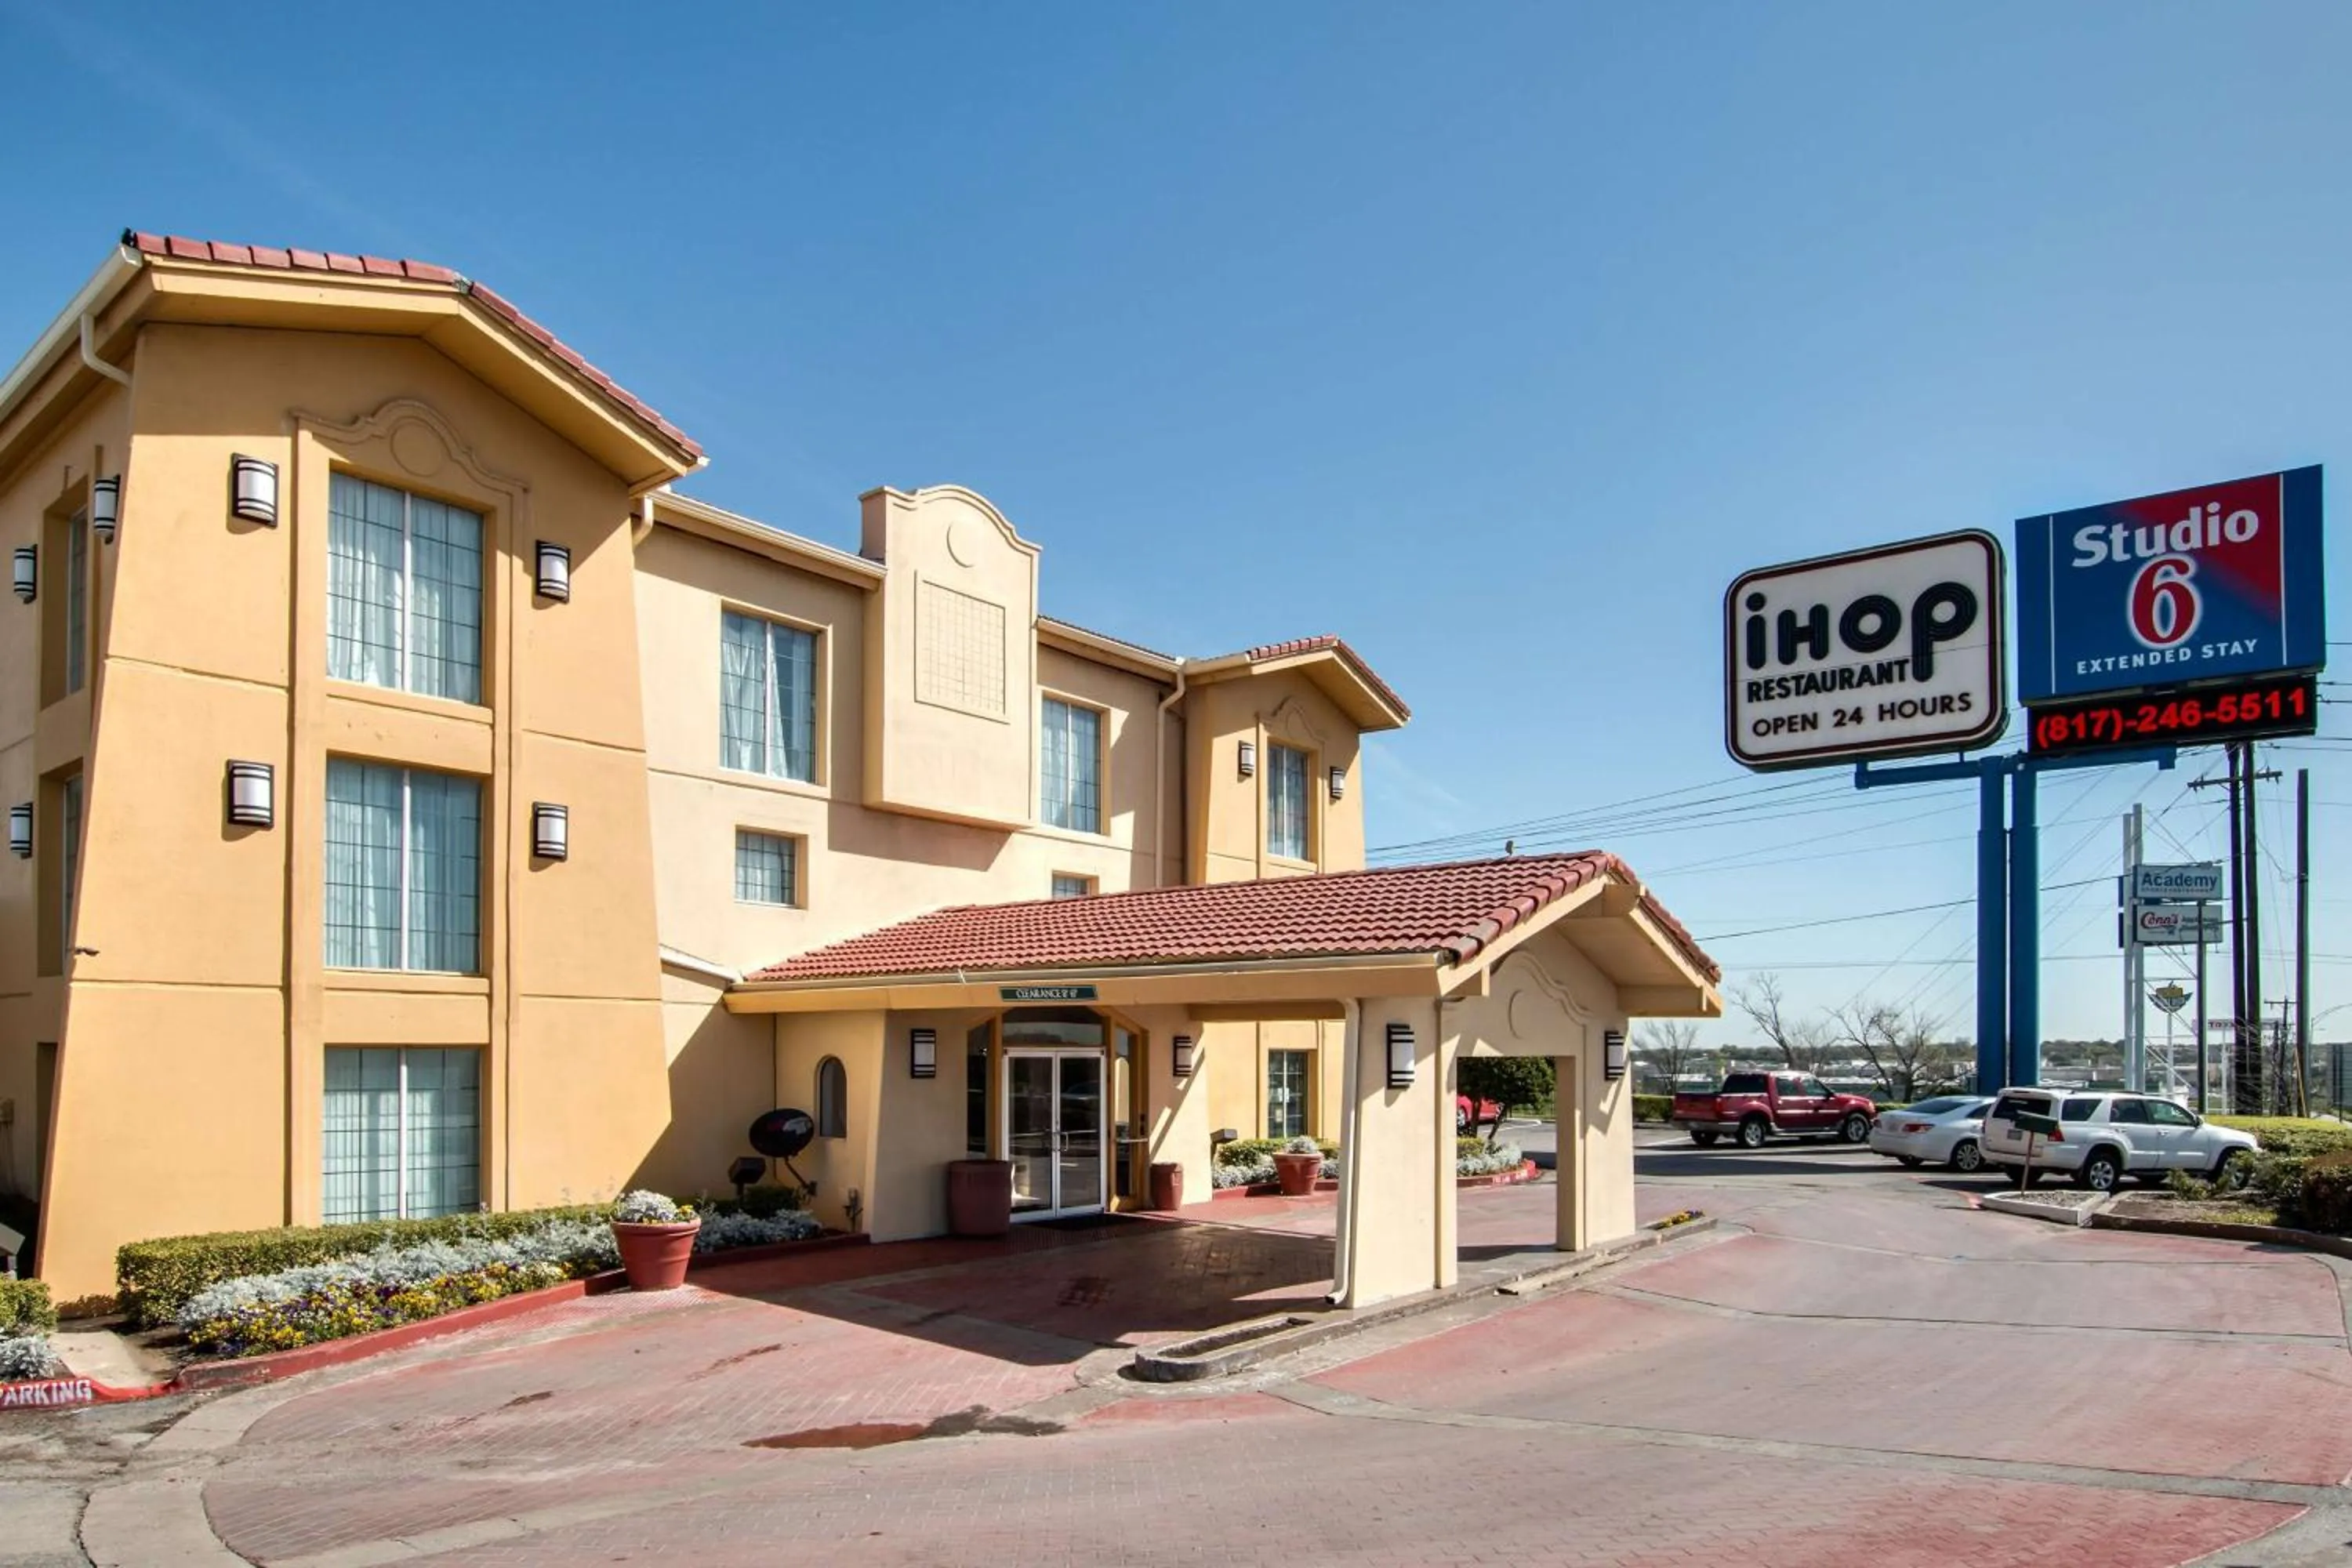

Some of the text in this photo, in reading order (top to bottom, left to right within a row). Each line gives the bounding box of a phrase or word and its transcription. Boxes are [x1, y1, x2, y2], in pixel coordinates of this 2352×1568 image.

[2071, 502, 2259, 568] Studio
[2127, 552, 2202, 649] 6
[2077, 639, 2259, 674] EXTENDED STAY
[1747, 659, 1910, 702] RESTAURANT
[1752, 692, 1972, 737] OPEN 24 HOURS
[2036, 687, 2306, 749] (817)-246-5511
[2141, 873, 2218, 891] Academy
